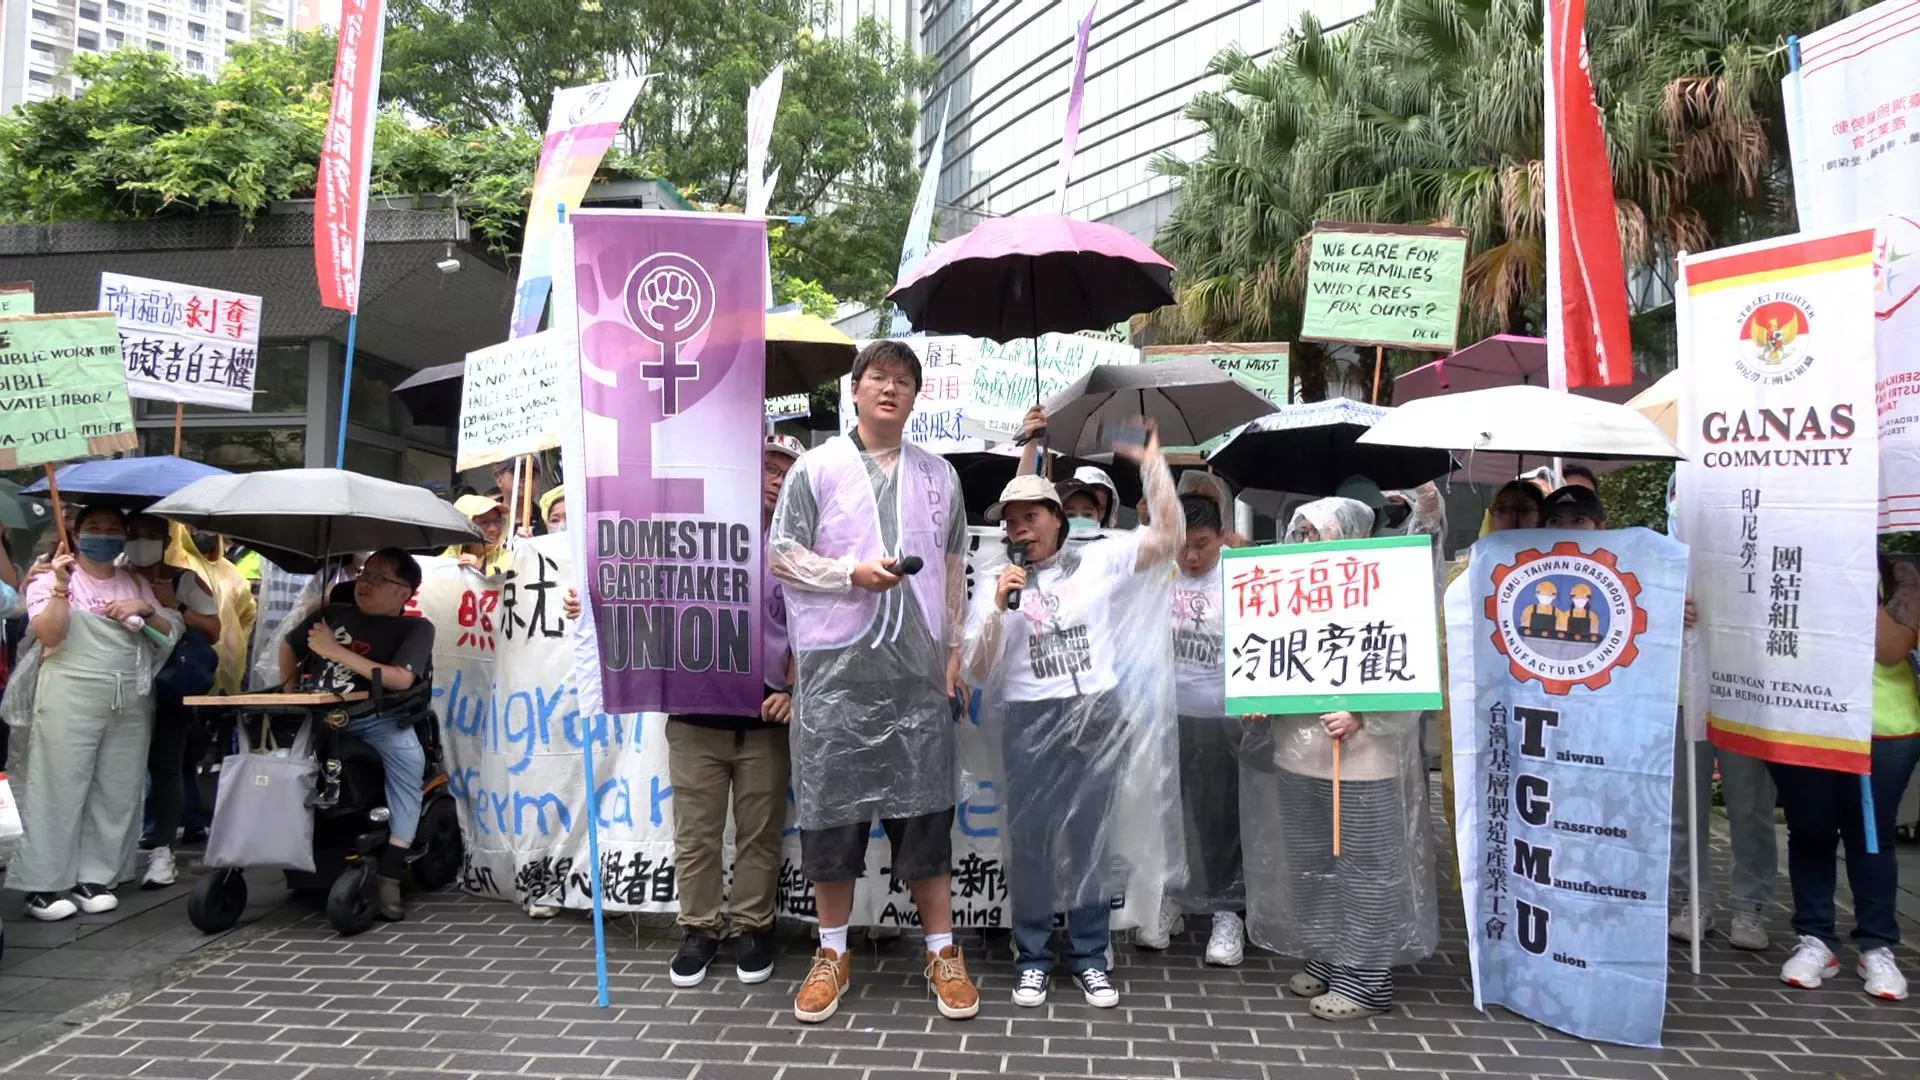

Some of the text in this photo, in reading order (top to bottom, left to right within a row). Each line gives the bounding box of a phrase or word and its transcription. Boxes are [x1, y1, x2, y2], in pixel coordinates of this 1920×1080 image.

[1313, 260, 1432, 282] YOUR FAMILIES
[1323, 243, 1438, 263] WE CARE FOR
[1313, 282, 1412, 299] WHO CARES
[1327, 300, 1361, 315] FOR
[51, 345, 95, 359] WORK
[1246, 358, 1280, 371] MUST
[1702, 403, 1856, 445] GANAS
[1703, 448, 1853, 468] COMMUNITY
[597, 518, 750, 564] DOMESTIC
[1739, 488, 1761, 595] 印尼勞工
[598, 562, 750, 604] CARETAKER
[1231, 556, 1381, 619] 衛福部
[1523, 560, 1569, 578] TAIWAN
[1574, 562, 1627, 615] GRASSROOTS
[1765, 546, 1803, 659] 團結組織
[600, 603, 751, 674] UNION
[1231, 620, 1416, 687] 冷眼旁觀
[1502, 620, 1624, 676] MANUFACTURES UNION
[1709, 684, 1732, 698] ERJA
[1770, 680, 1833, 697] TENAGA
[1485, 701, 1510, 940] 台灣基層製造產業工會
[879, 902, 1002, 927] Awaning
